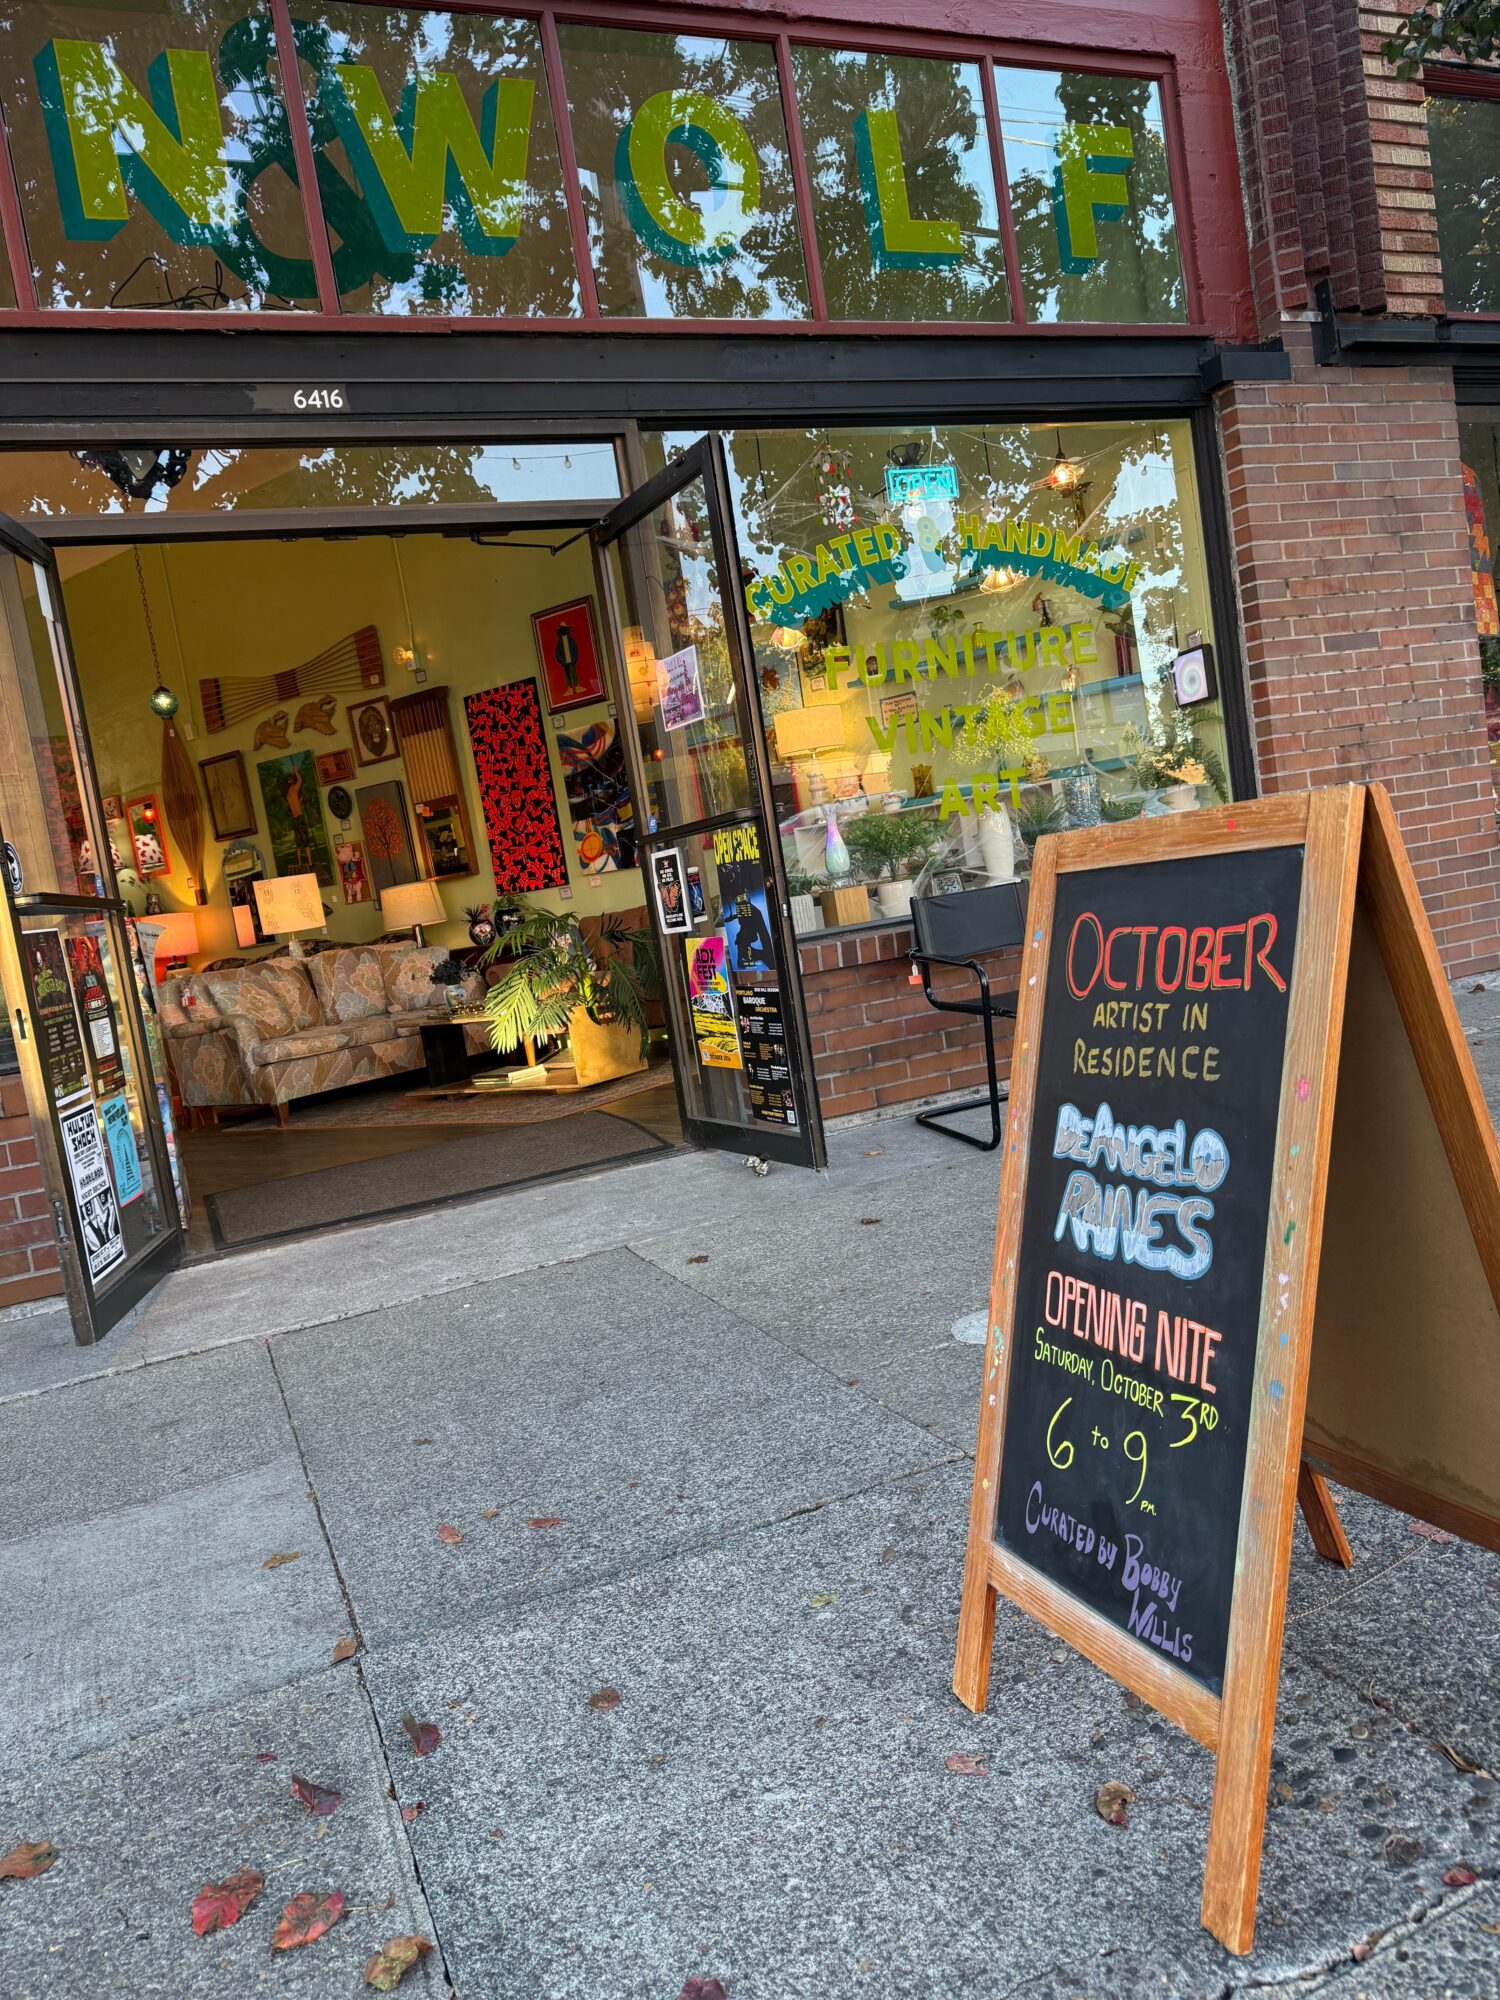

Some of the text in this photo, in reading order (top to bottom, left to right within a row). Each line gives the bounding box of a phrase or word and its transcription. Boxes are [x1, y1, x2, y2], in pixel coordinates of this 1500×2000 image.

[319, 64, 1135, 274] WOLF
[293, 389, 343, 409] 6416
[896, 473, 951, 495] OPEN
[745, 514, 1145, 619] CURATED & HANDMADE
[825, 624, 1097, 690] FURNITURE
[866, 693, 1075, 753] VINTAGE
[939, 768, 1026, 820] ART
[713, 826, 760, 865] OPEN SPACE
[696, 948, 716, 964] ADX
[697, 965, 717, 980] FEST
[1067, 912, 1287, 1000] OCTOBER
[743, 996, 767, 1006] BAROQUE
[1092, 1001, 1209, 1033] ARTIST IN
[1073, 1038, 1221, 1082] RESIDENCE
[66, 1112, 95, 1138] KULTUR
[71, 1127, 97, 1153] SHOCK
[1045, 1271, 1222, 1394] OPENING NITE
[1034, 1326, 1095, 1386] SATURDAY,
[1101, 1358, 1164, 1418] OCTOBER
[1046, 1397, 1074, 1469] 6
[1091, 1425, 1109, 1449] to
[1124, 1431, 1147, 1504] 9
[1025, 1480, 1182, 1612] CURATED BY BOBBY
[1127, 1587, 1193, 1664] WILLIS
